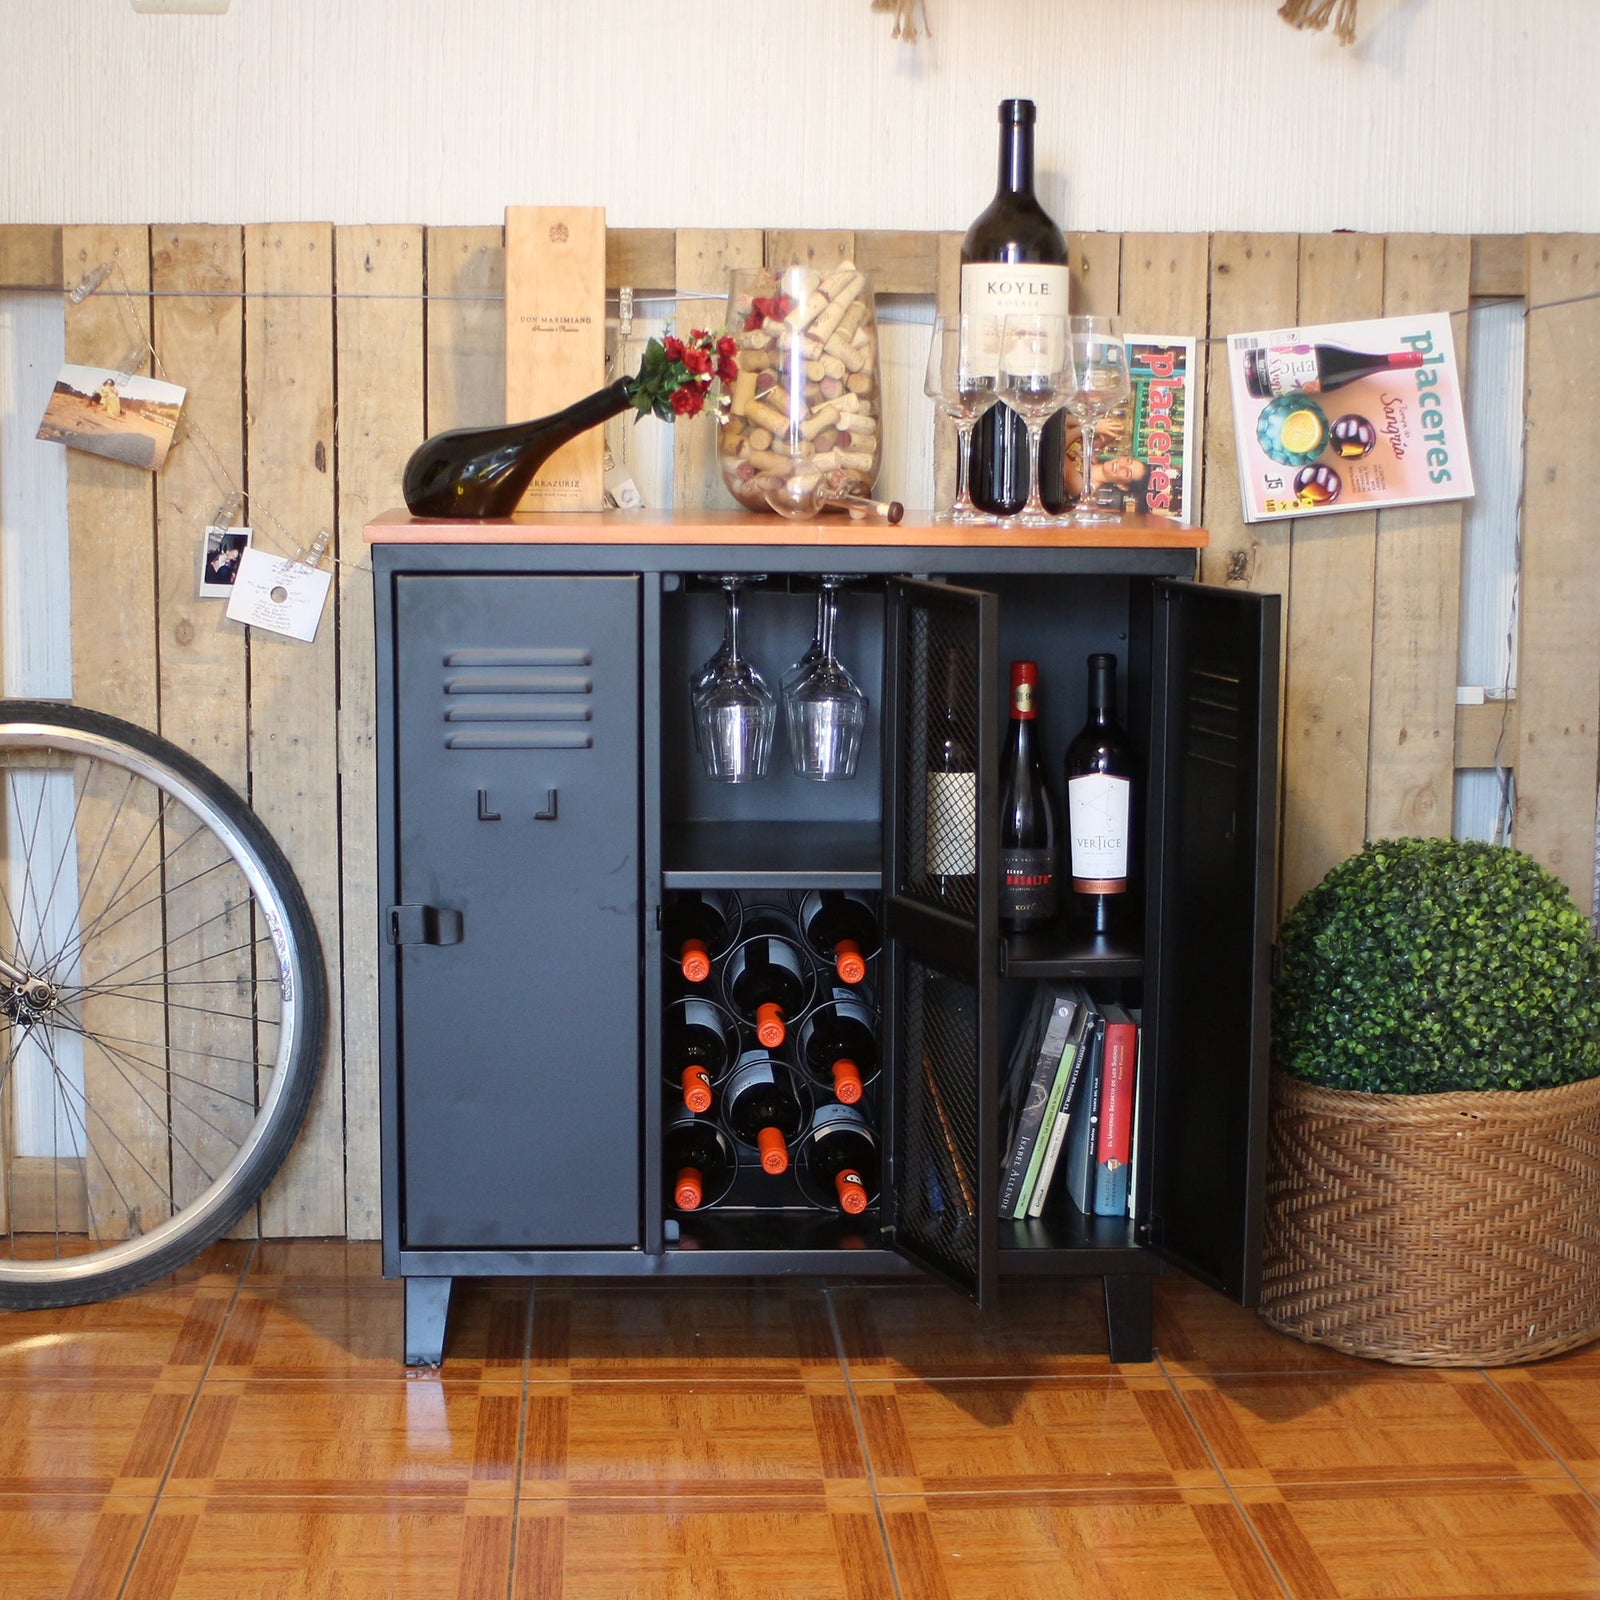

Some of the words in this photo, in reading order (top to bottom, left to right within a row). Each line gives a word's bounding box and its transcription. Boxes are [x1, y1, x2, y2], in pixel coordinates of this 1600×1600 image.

[987, 282, 1048, 295] KOYLE
[520, 315, 538, 323] DON
[541, 316, 591, 324] MAXIMIANO
[1401, 330, 1452, 485] placeres
[1140, 352, 1183, 508] placeres
[1077, 836, 1121, 850] VERTICE
[1108, 1087, 1116, 1112] SECRETO
[1014, 1135, 1030, 1167] ISABEL
[1001, 1168, 1020, 1210] ALLENDE
